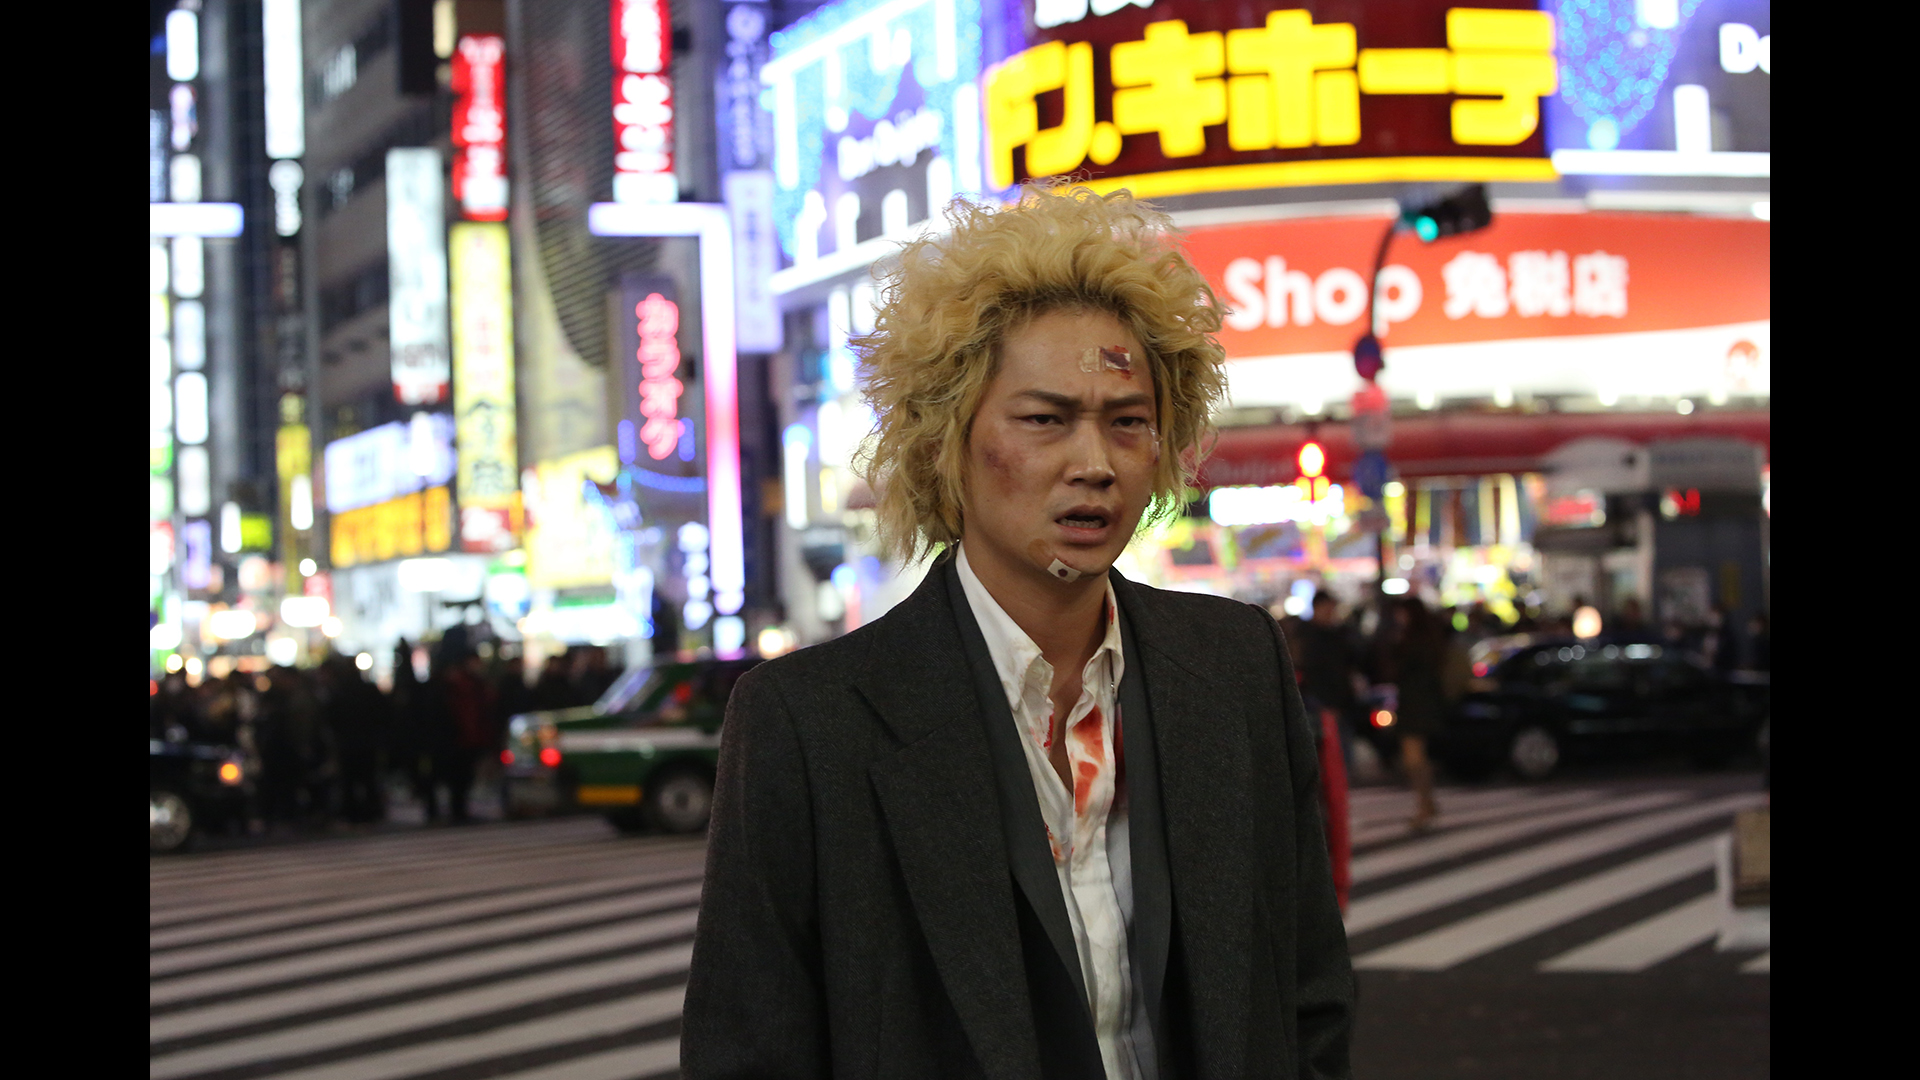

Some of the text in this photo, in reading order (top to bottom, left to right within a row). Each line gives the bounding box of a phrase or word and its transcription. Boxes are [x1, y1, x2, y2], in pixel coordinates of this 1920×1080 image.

[1223, 249, 1630, 338] Shop 免税店
[635, 292, 686, 460] カラオケ
